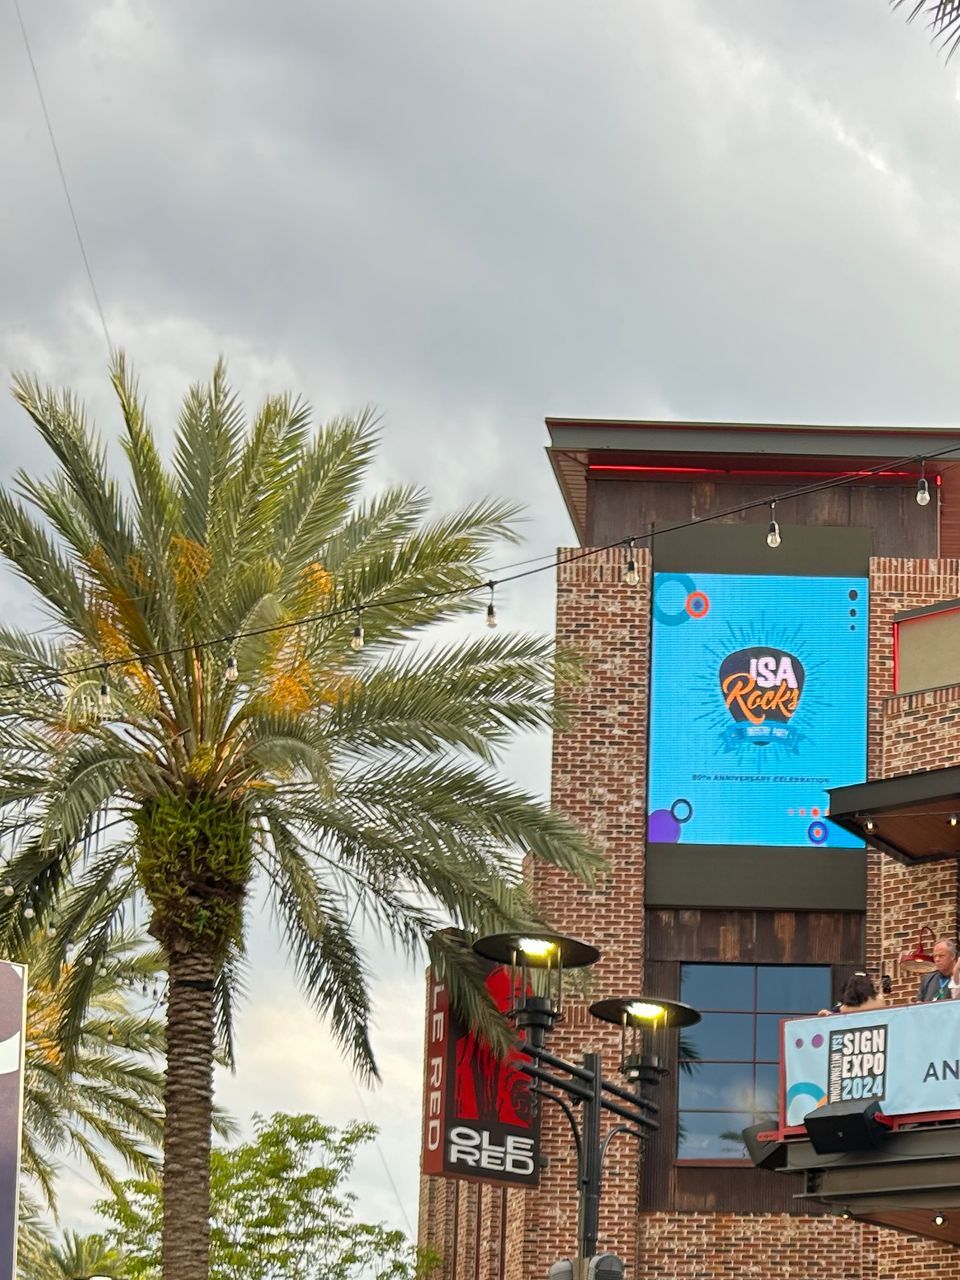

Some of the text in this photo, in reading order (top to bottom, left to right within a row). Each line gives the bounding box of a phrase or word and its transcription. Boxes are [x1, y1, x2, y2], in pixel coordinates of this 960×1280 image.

[749, 656, 799, 689] ISA
[722, 673, 800, 726] Rocks
[842, 1029, 885, 1055] SIGN
[830, 1034, 844, 1104] ISA INTERNATIONAL
[842, 1053, 885, 1078] EXPO
[427, 1056, 443, 1152] RED
[842, 1075, 883, 1100] 2024
[449, 1126, 535, 1157] OLE
[449, 1143, 536, 1176] RED
